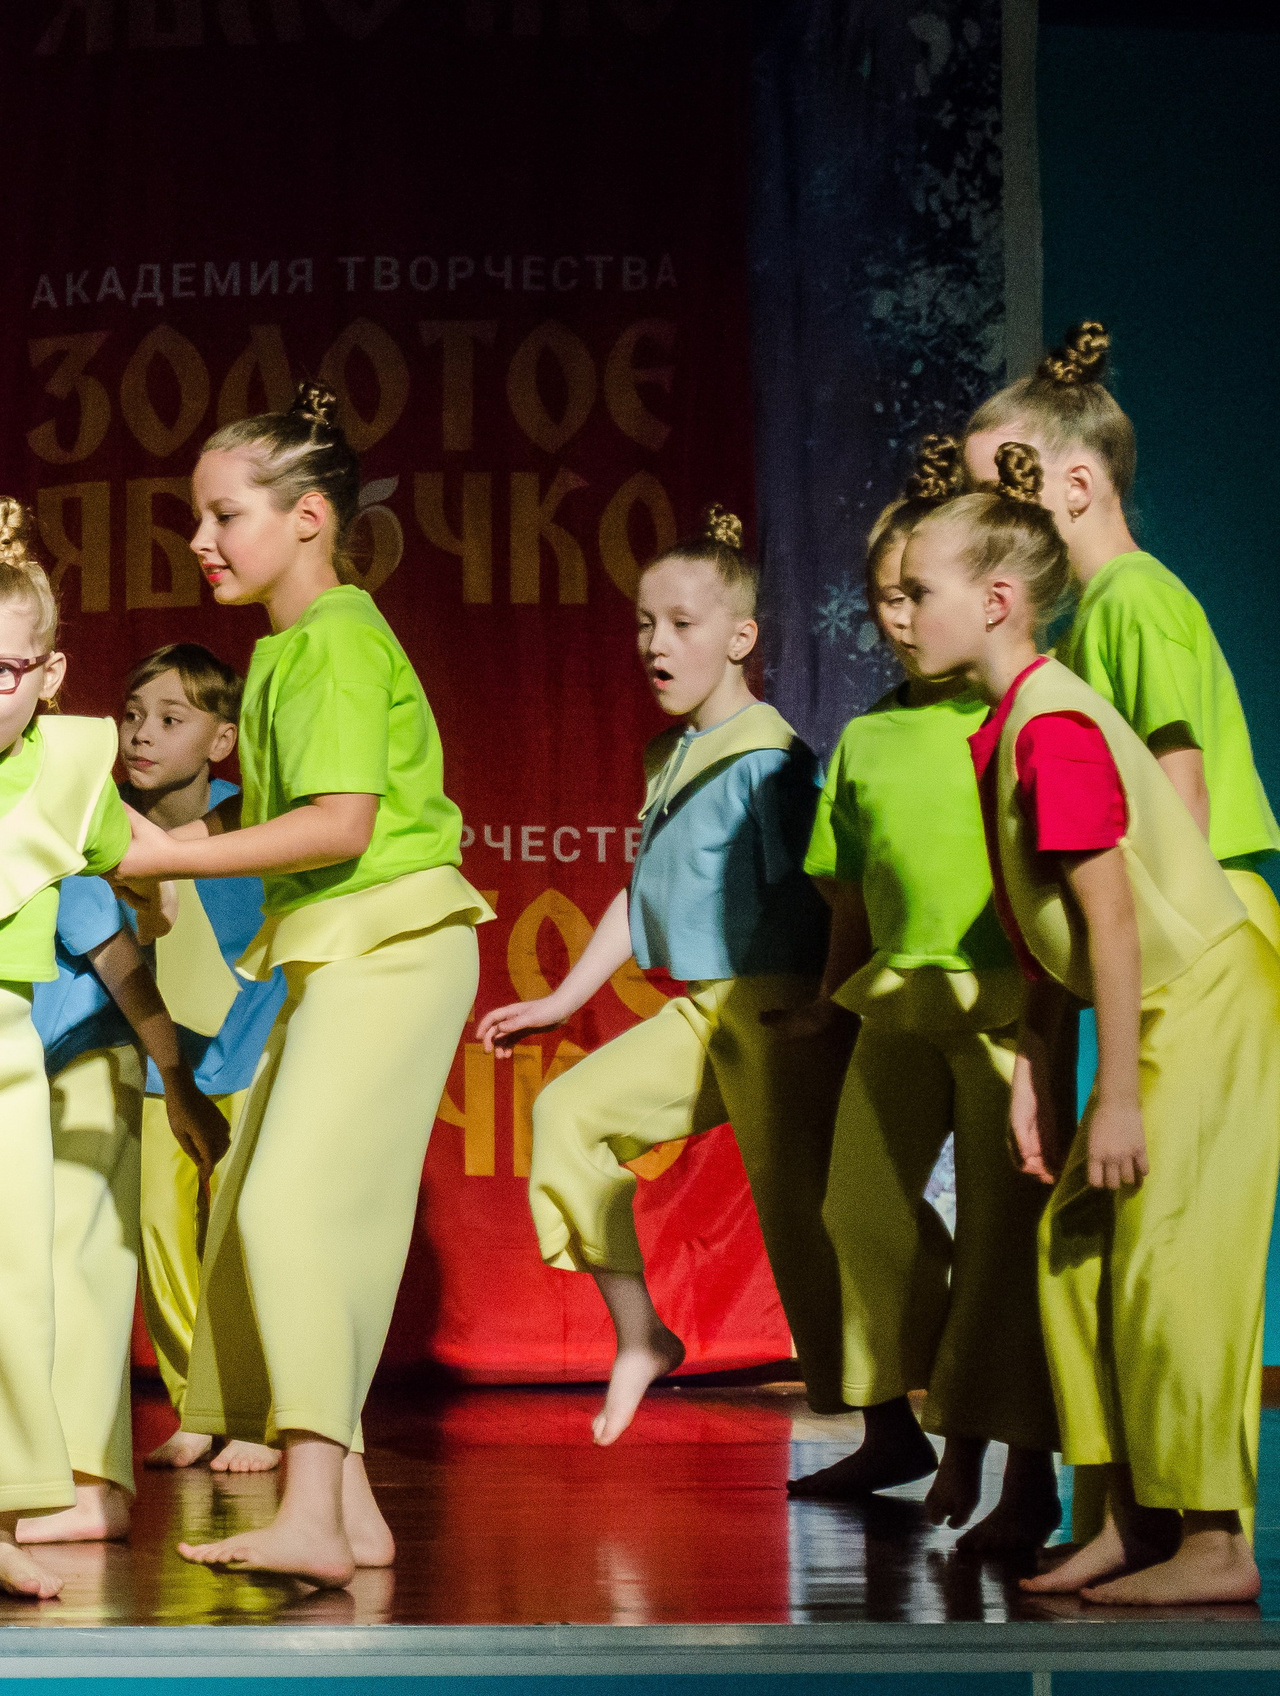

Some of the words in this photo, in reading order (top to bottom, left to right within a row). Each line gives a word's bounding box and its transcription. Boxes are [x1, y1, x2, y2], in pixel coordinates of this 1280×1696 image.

[31, 258, 314, 309] АКАДЕМИЯ
[337, 253, 678, 293] ТВОРЧЕСТВА
[25, 316, 680, 464] ЗОЛОТОЕ
[36, 467, 677, 614] ЯБОЧКО
